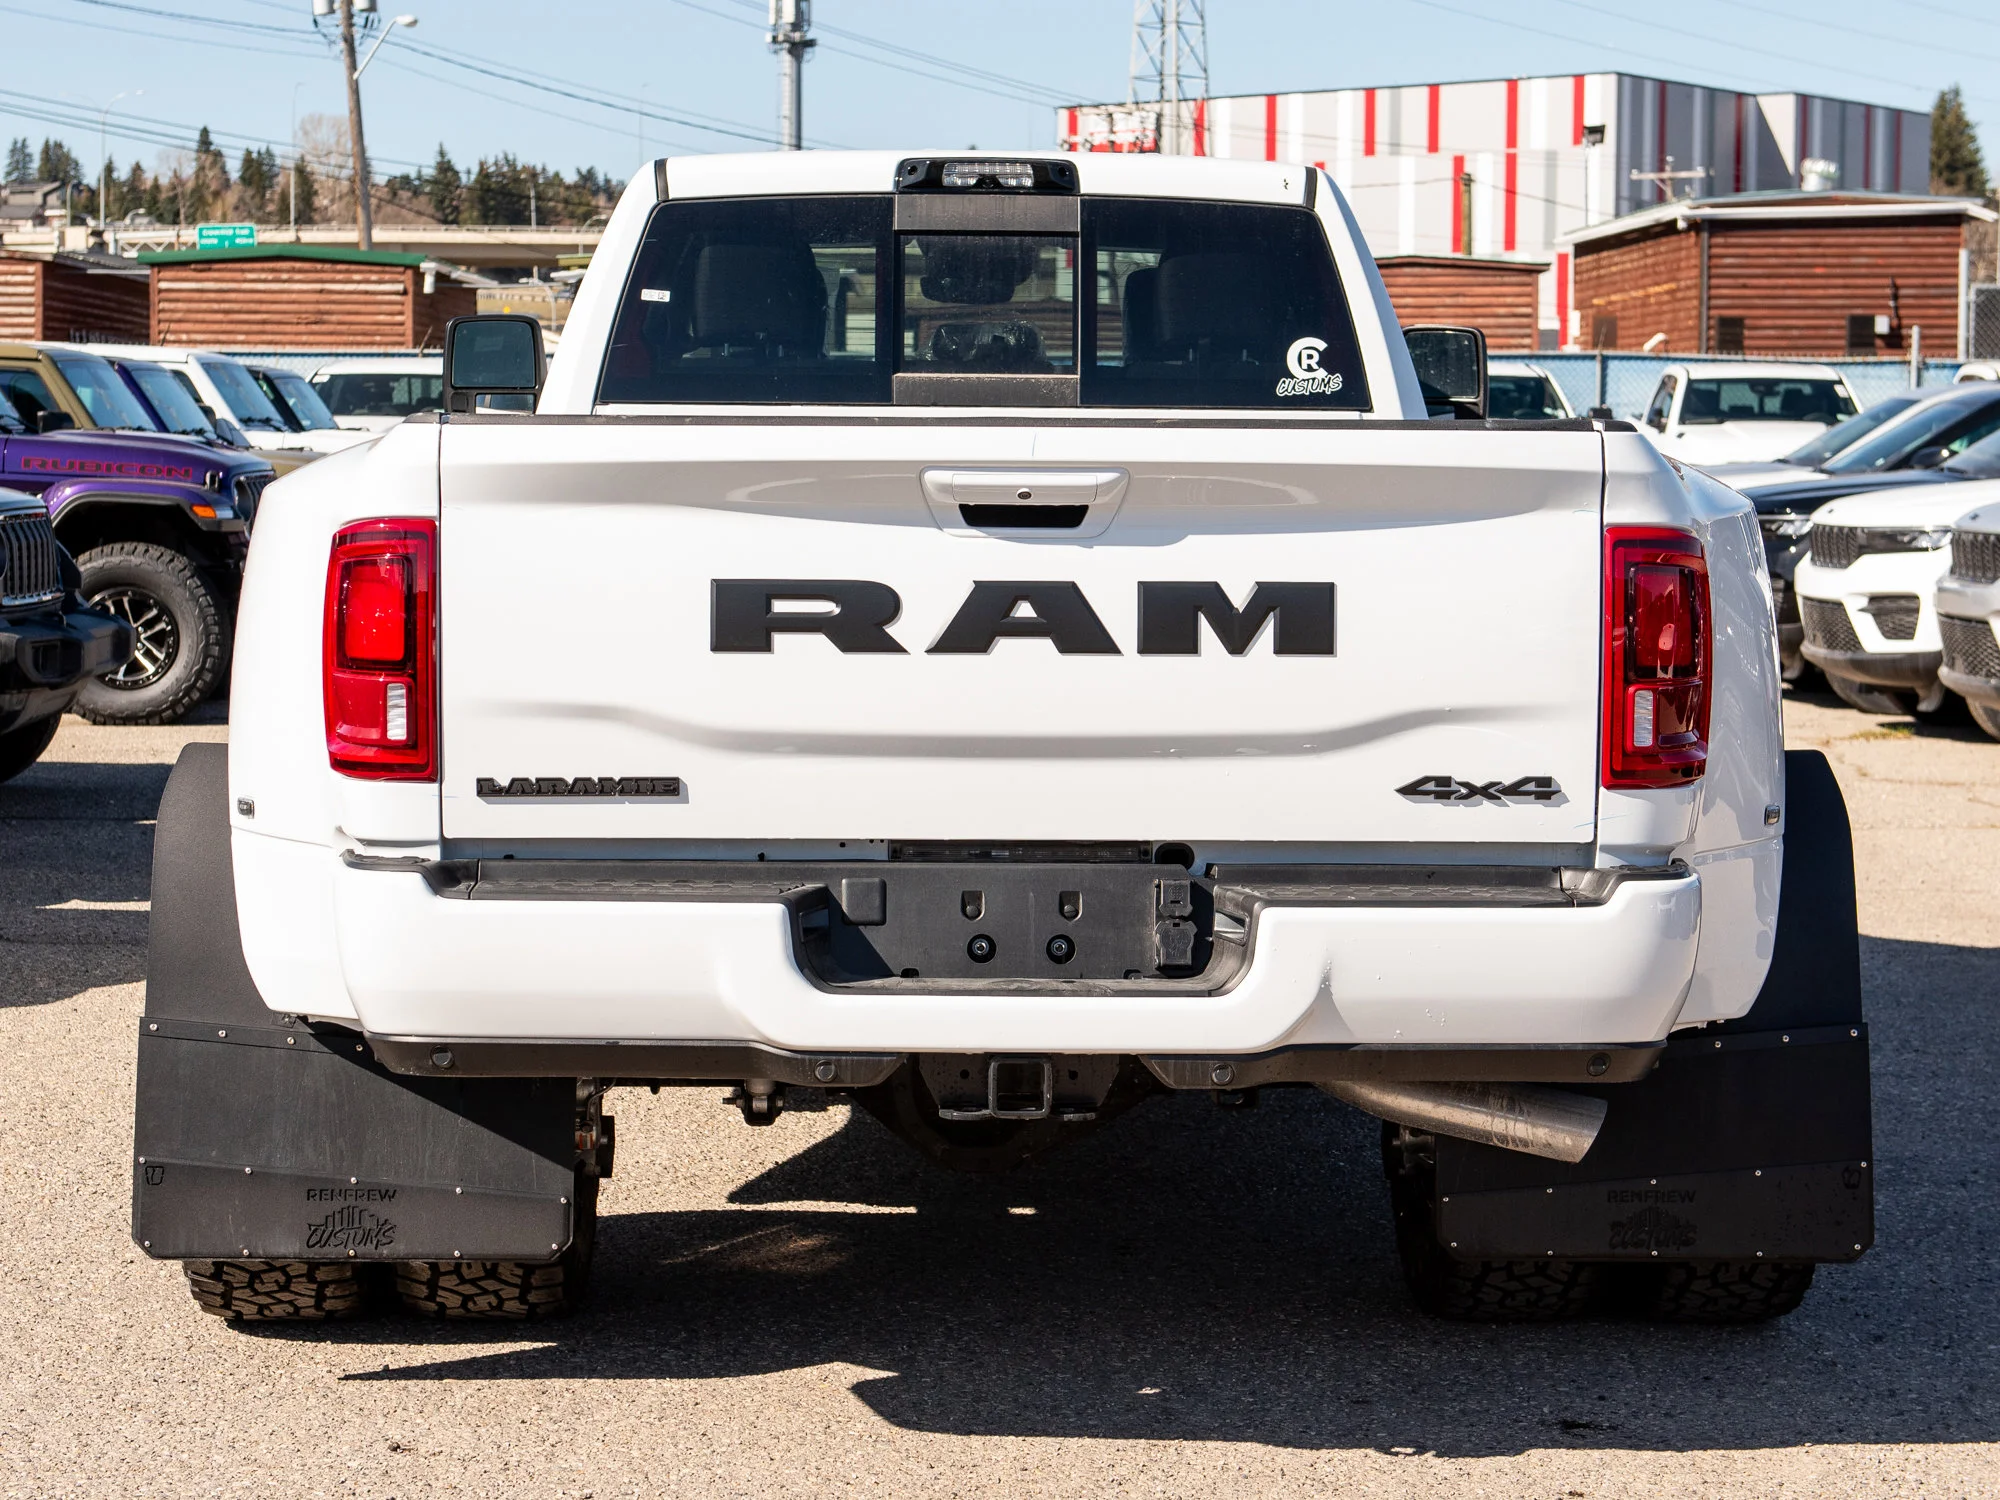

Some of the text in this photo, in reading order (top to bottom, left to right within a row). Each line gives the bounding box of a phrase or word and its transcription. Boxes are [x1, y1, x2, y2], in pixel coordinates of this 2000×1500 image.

[1276, 373, 1343, 396] CUSTOMS
[21, 456, 193, 479] RUBICON
[710, 578, 1335, 656] RAM
[476, 777, 680, 796] LARAMIE
[1394, 775, 1563, 800] 4x4
[306, 1187, 398, 1202] RENFREW
[1607, 1189, 1697, 1203] RENFREW
[306, 1223, 398, 1251] CUSTOMS
[1608, 1223, 1699, 1252] CUSTOMS
